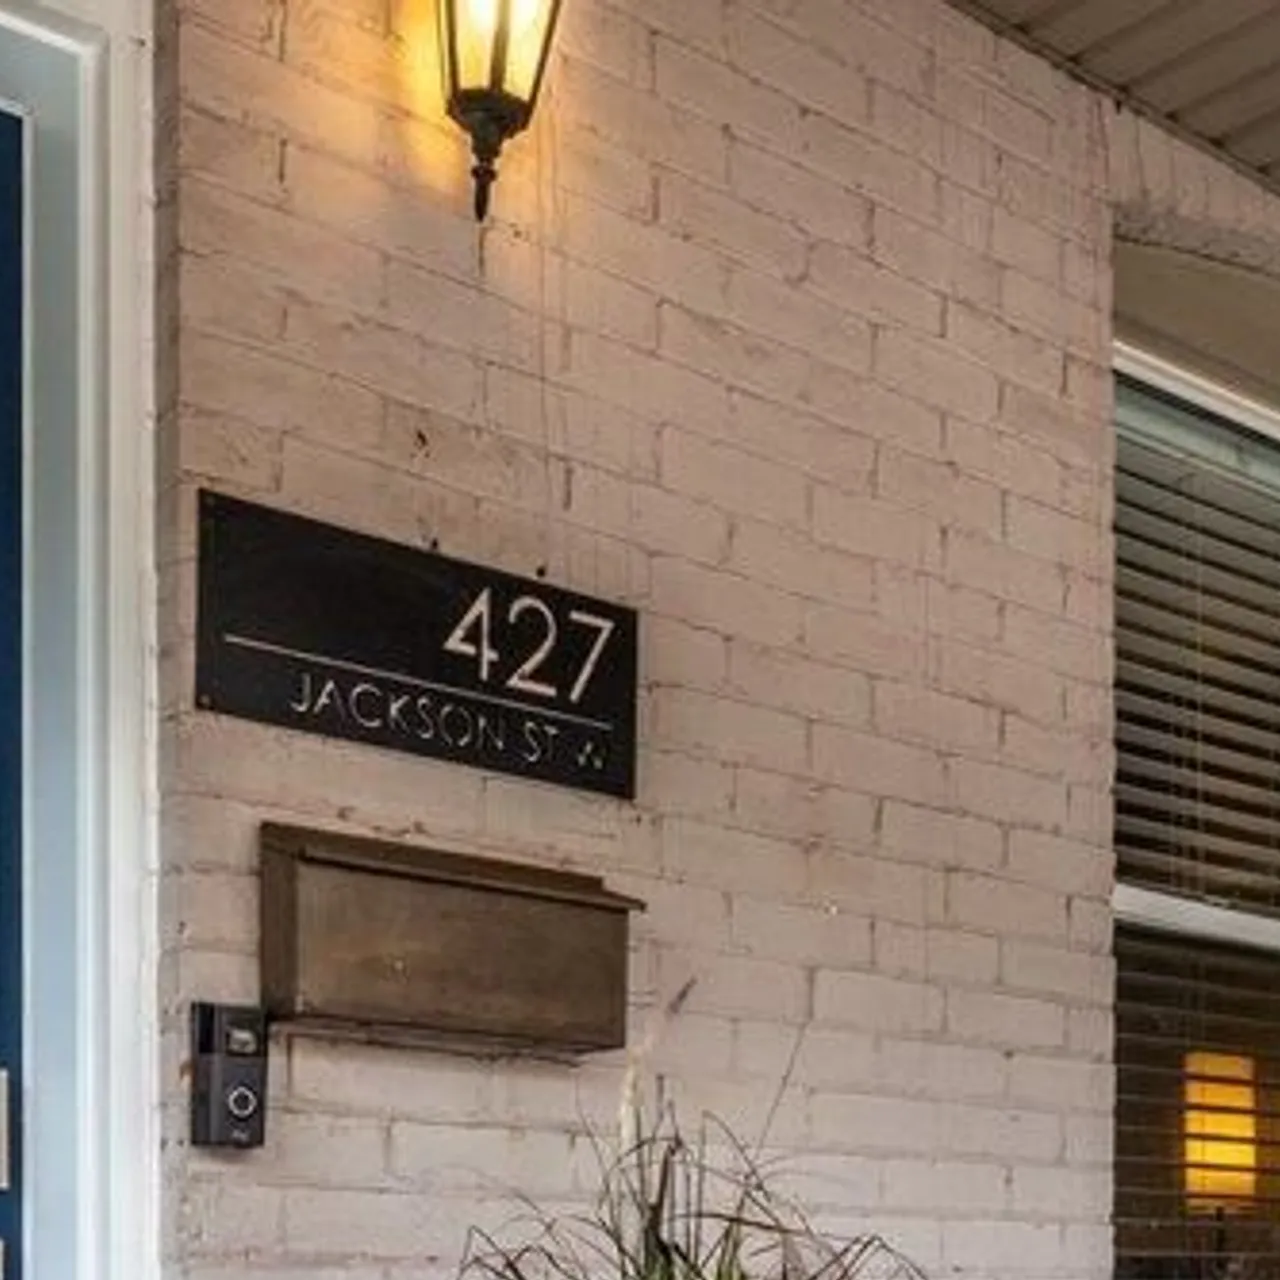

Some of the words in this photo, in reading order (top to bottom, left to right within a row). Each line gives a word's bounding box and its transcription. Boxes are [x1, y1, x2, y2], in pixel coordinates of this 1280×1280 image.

[442, 586, 616, 704] 427
[289, 672, 505, 751] JACKSON
[523, 720, 559, 763] ST
